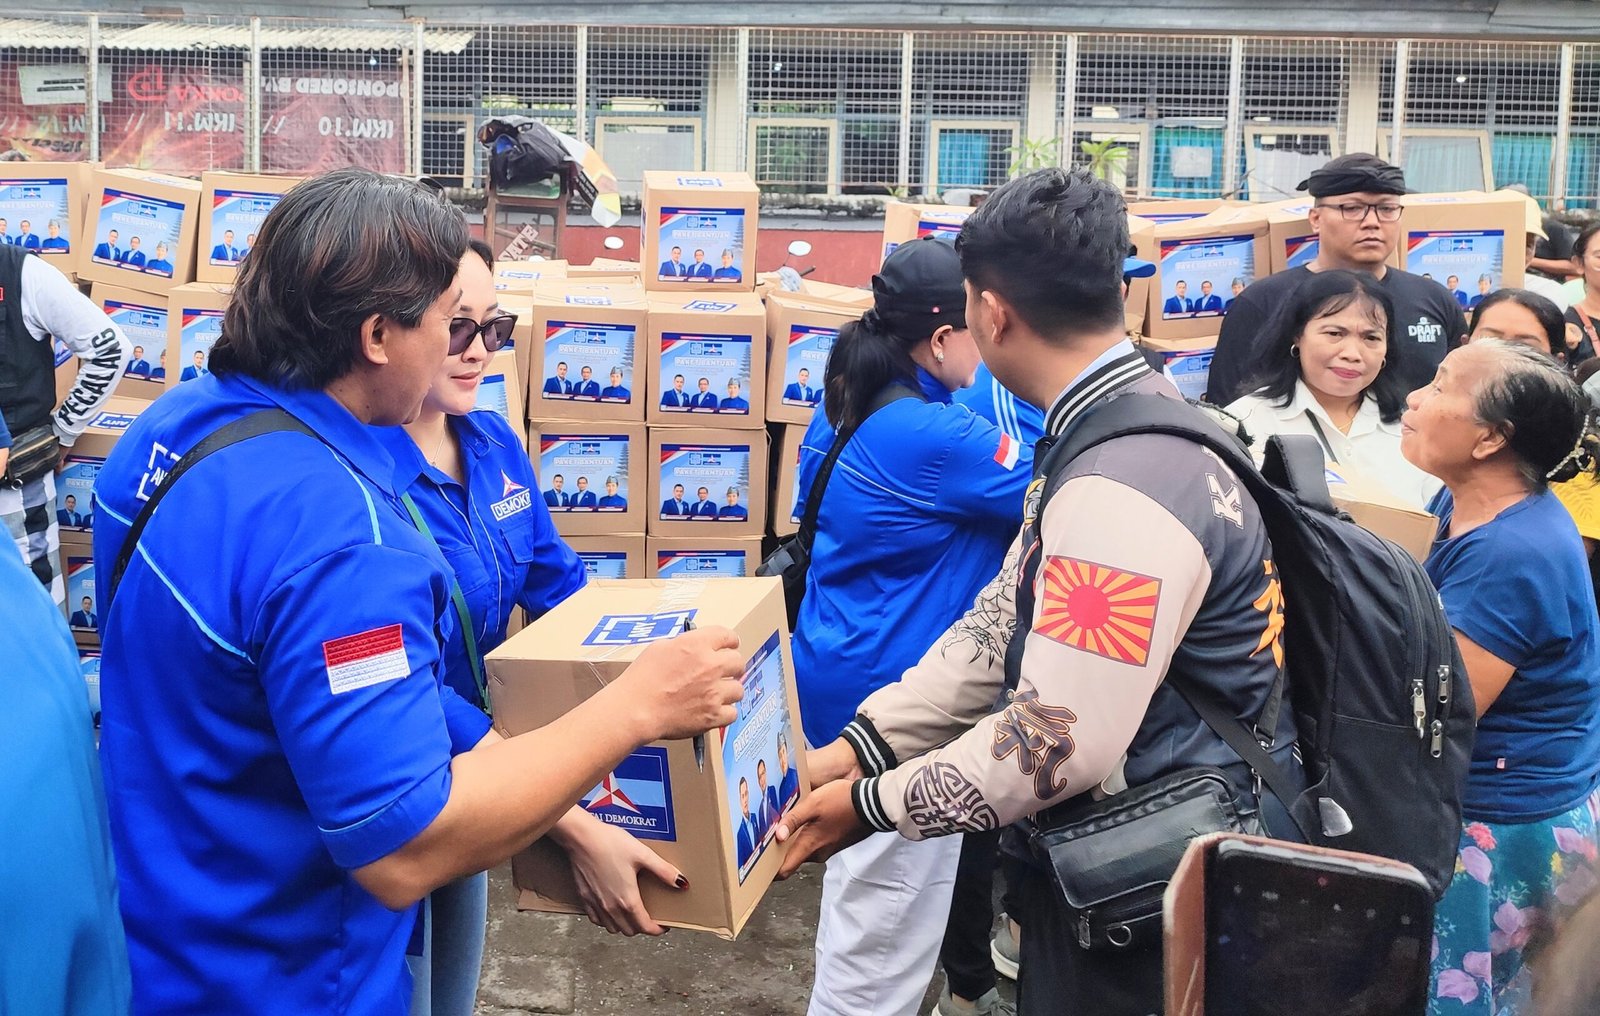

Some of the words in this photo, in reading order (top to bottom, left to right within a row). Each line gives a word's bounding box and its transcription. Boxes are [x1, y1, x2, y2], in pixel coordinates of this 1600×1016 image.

[38, 113, 106, 133] IM'12
[1408, 324, 1441, 336] DRAFT
[59, 328, 121, 426] PECALANG
[1205, 472, 1244, 529] K
[605, 813, 657, 826] DEMOKRAT
